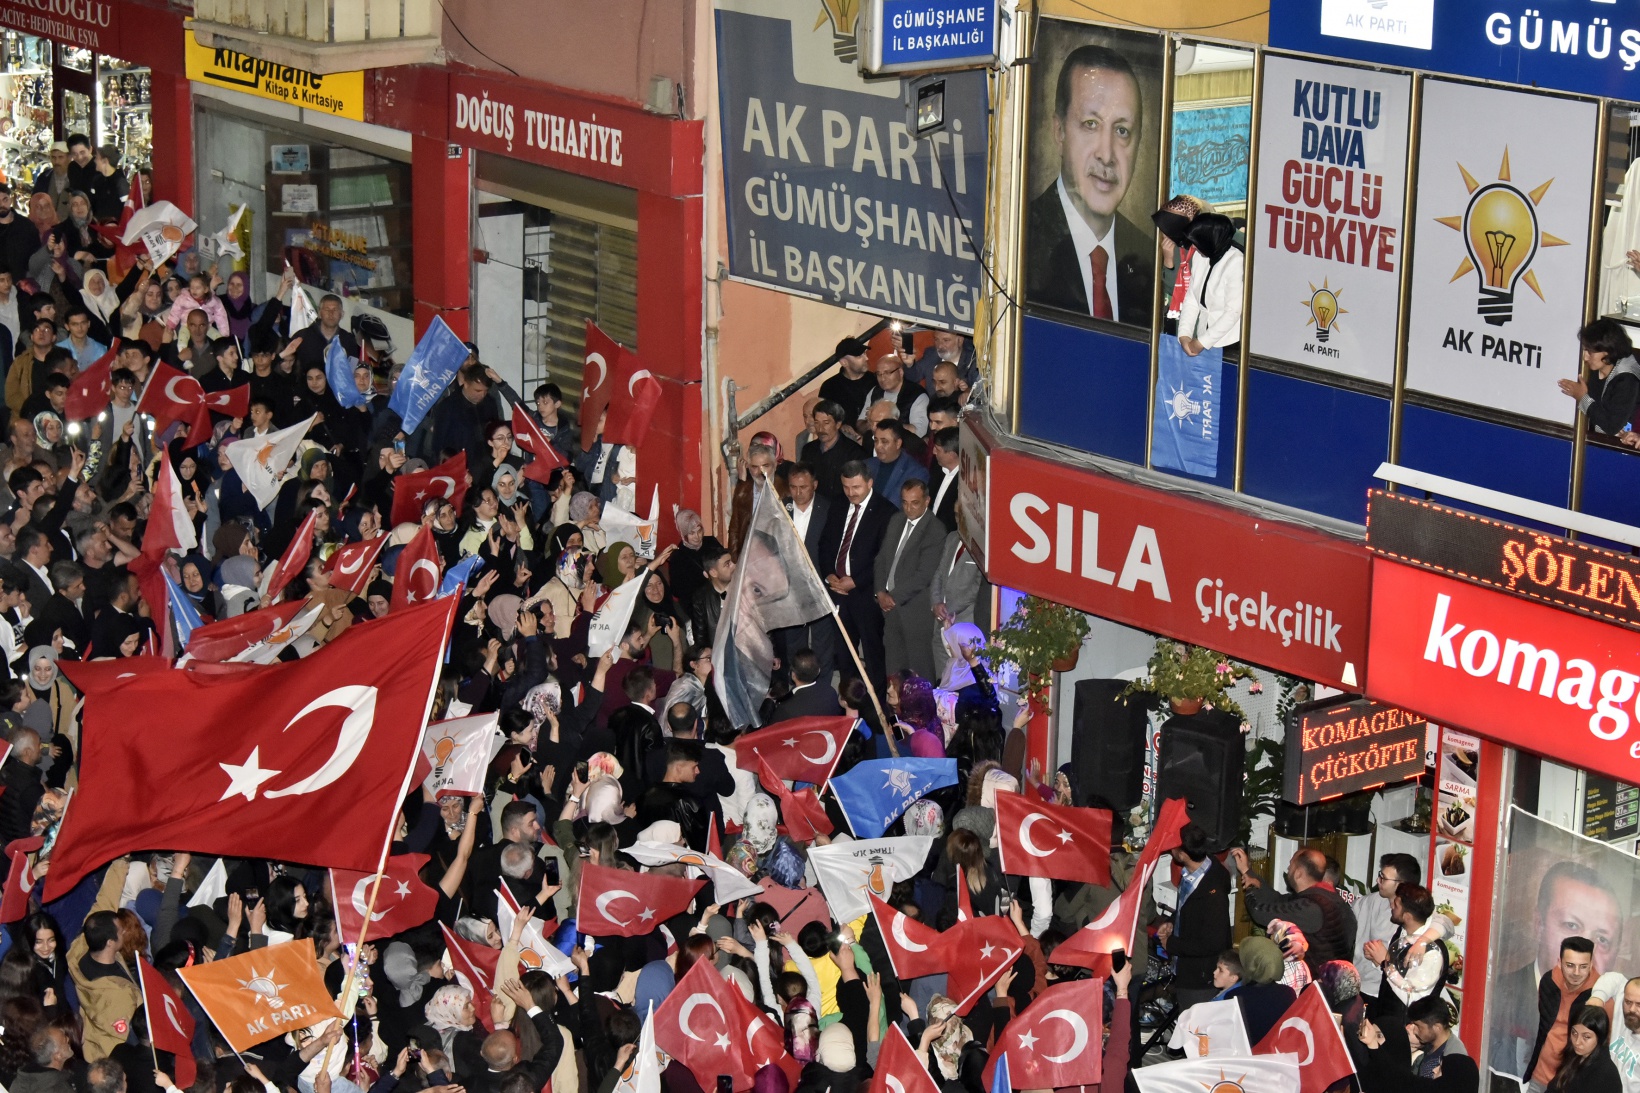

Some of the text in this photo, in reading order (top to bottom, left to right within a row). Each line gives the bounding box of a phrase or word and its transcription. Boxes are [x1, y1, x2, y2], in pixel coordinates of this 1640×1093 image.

[0, 6, 26, 28] ACİYE
[78, 28, 99, 48] EŞYA
[893, 7, 985, 29] GÜMÜŞHANE
[893, 28, 984, 51] İL BAŞKANLIĞI
[1346, 14, 1363, 28] AK
[265, 80, 344, 113] Kitap & Kırtasiye
[1293, 79, 1381, 131] KUTLU
[456, 90, 623, 167] DOĞUŞ TUHAFİYE
[743, 97, 811, 163] AK
[1301, 121, 1366, 170] DAVA
[1282, 159, 1383, 220] GÜÇLÜ
[744, 171, 976, 261] GÜMÜŞHANE
[1264, 204, 1397, 273] TÜRKİYE
[749, 230, 778, 278] İL
[1303, 343, 1315, 354] AK
[1442, 327, 1474, 354] AK
[1010, 492, 1171, 603] SILA
[1195, 577, 1342, 653] Çiçekçilik
[1424, 593, 1640, 740] komag
[1310, 739, 1418, 790] ÇİĞKÖFTE
[1445, 783, 1470, 795] SARMA
[884, 808, 899, 828] AK
[246, 1017, 269, 1036] AK
